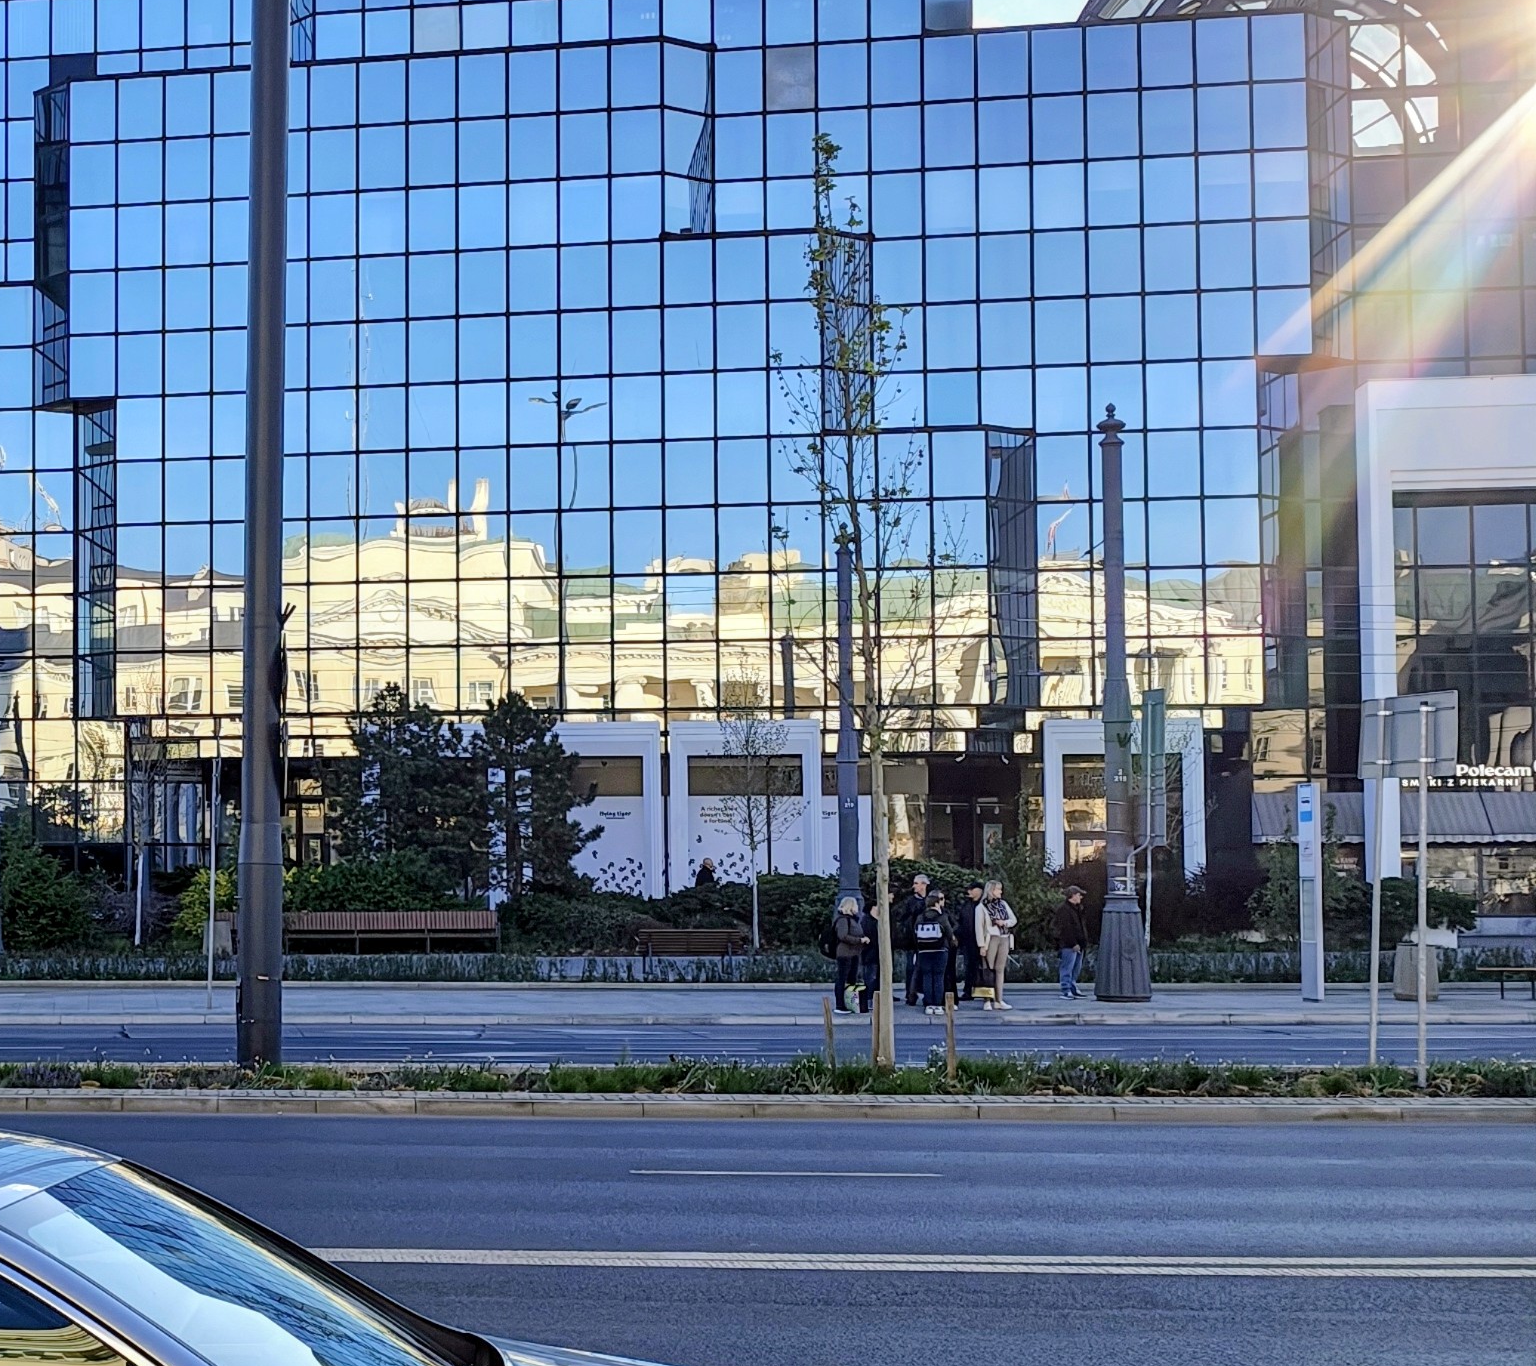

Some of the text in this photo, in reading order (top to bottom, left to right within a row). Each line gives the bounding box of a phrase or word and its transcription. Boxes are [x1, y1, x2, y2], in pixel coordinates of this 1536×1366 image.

[1456, 764, 1532, 777] Polecam
[1402, 778, 1519, 787] SMKI Z PIEKARNI
